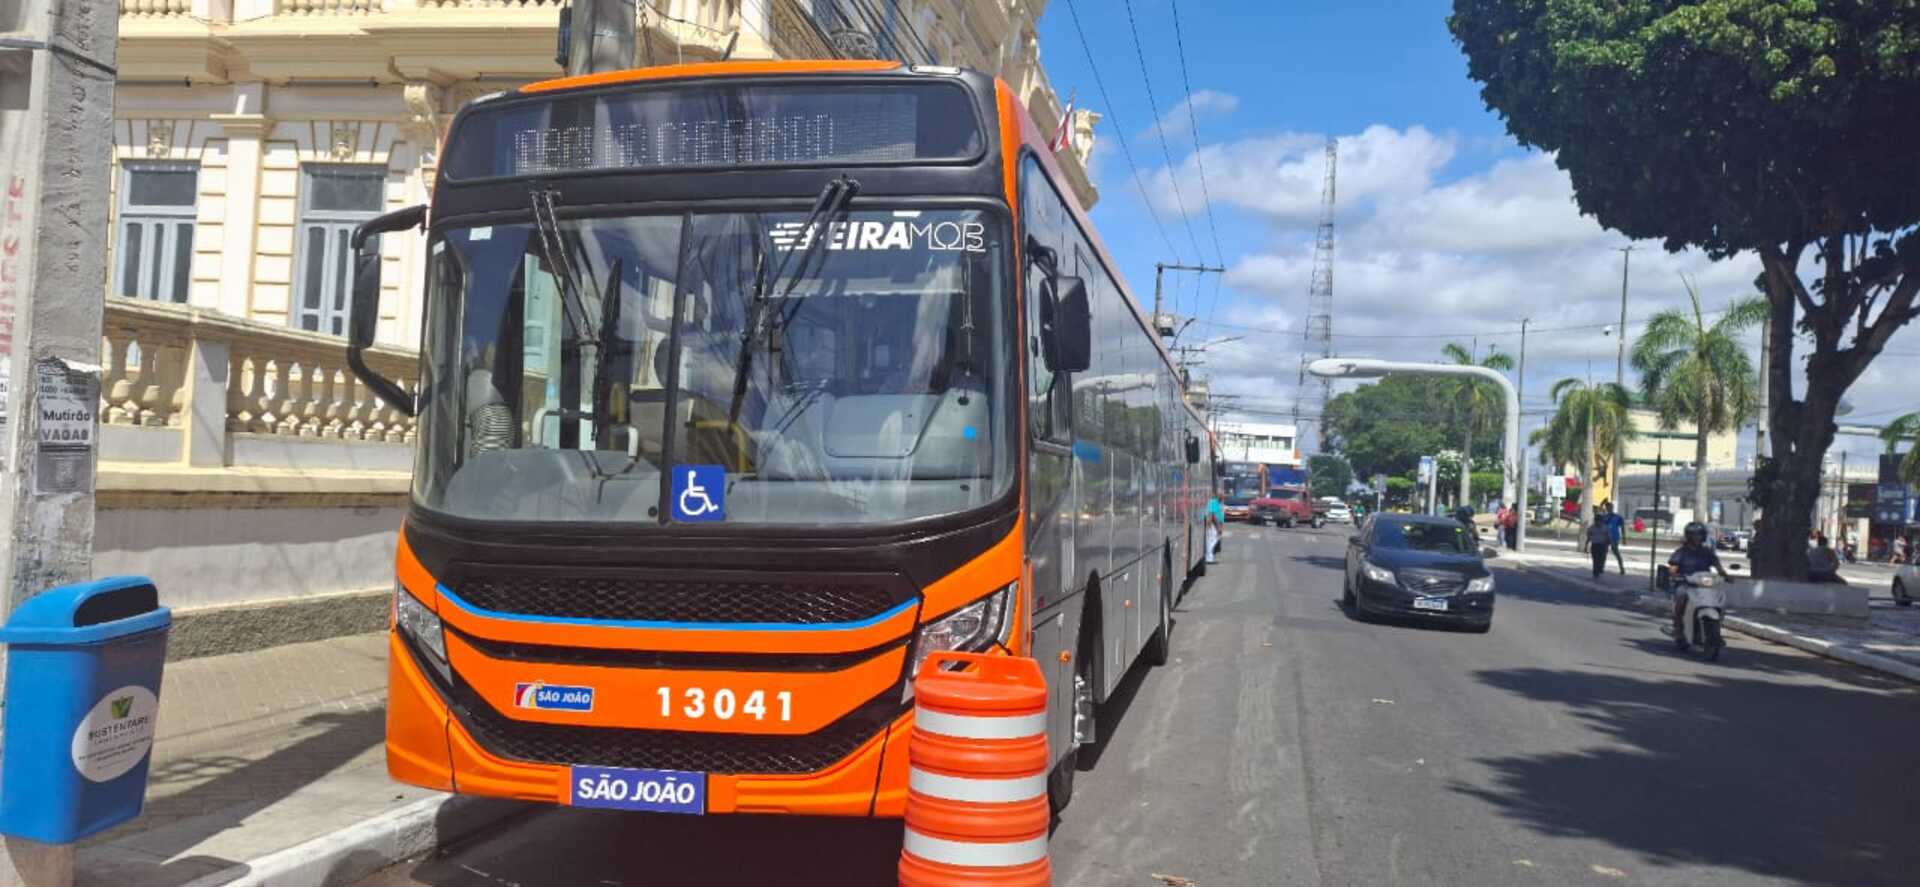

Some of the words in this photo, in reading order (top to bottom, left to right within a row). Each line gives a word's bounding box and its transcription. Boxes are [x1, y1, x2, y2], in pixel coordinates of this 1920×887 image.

[43, 407, 91, 422] Mutirão
[42, 428, 89, 441] VAGAS
[537, 688, 560, 702] SÃO
[561, 690, 590, 704] JOÃO
[657, 686, 793, 721] 13041
[577, 773, 628, 802] SÃO
[630, 776, 696, 805] JOÃO
